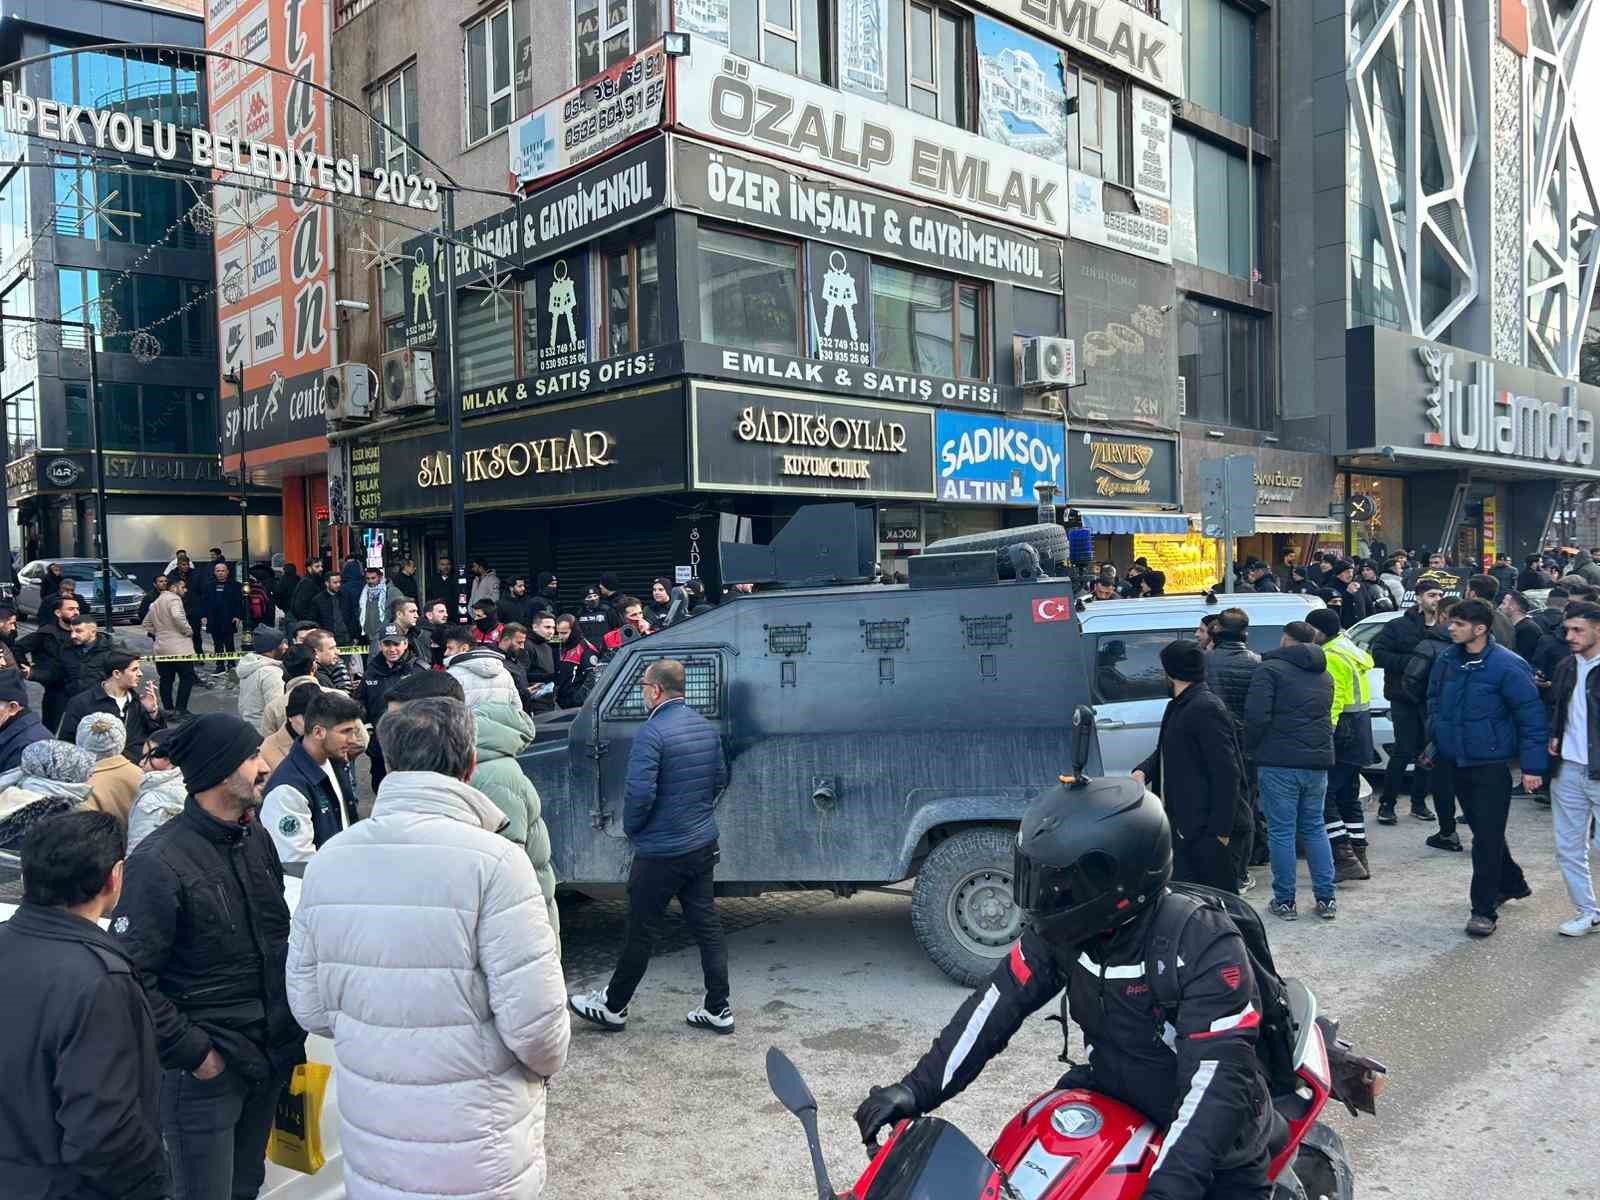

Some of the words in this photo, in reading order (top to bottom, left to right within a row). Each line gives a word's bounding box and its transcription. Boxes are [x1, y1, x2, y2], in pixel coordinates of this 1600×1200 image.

[565, 115, 598, 150] 0532
[710, 55, 895, 173] ÖZALP
[911, 136, 1058, 227] EMLAK
[192, 127, 362, 197] BELEDİYESİ
[374, 167, 440, 211] 2023
[472, 219, 519, 270] İNŞAAT
[523, 214, 537, 248] &
[540, 161, 653, 241] GAYRİMENKUL
[707, 153, 782, 217] ÖZER
[789, 174, 877, 233] İNŞAAT
[883, 209, 903, 245] &
[909, 215, 1044, 279] GAYRİMENKUL
[834, 338, 848, 350] 749
[860, 342, 869, 353] 03
[849, 353, 859, 364] 25
[516, 384, 528, 400] &
[536, 368, 591, 397] SATIŞ
[722, 350, 823, 383] EMLAK
[835, 366, 852, 386] &
[863, 373, 932, 400] SATIŞ
[225, 394, 259, 445] sprt
[289, 377, 326, 422] cente
[739, 407, 907, 453] SADIKSOYLAR
[418, 431, 610, 487] SAIKSOYLAR
[784, 455, 870, 479] KUYUMCULUK
[942, 427, 1060, 481] SADIKSOY
[943, 480, 1007, 501] ALTIN
[690, 527, 700, 580] SADI
